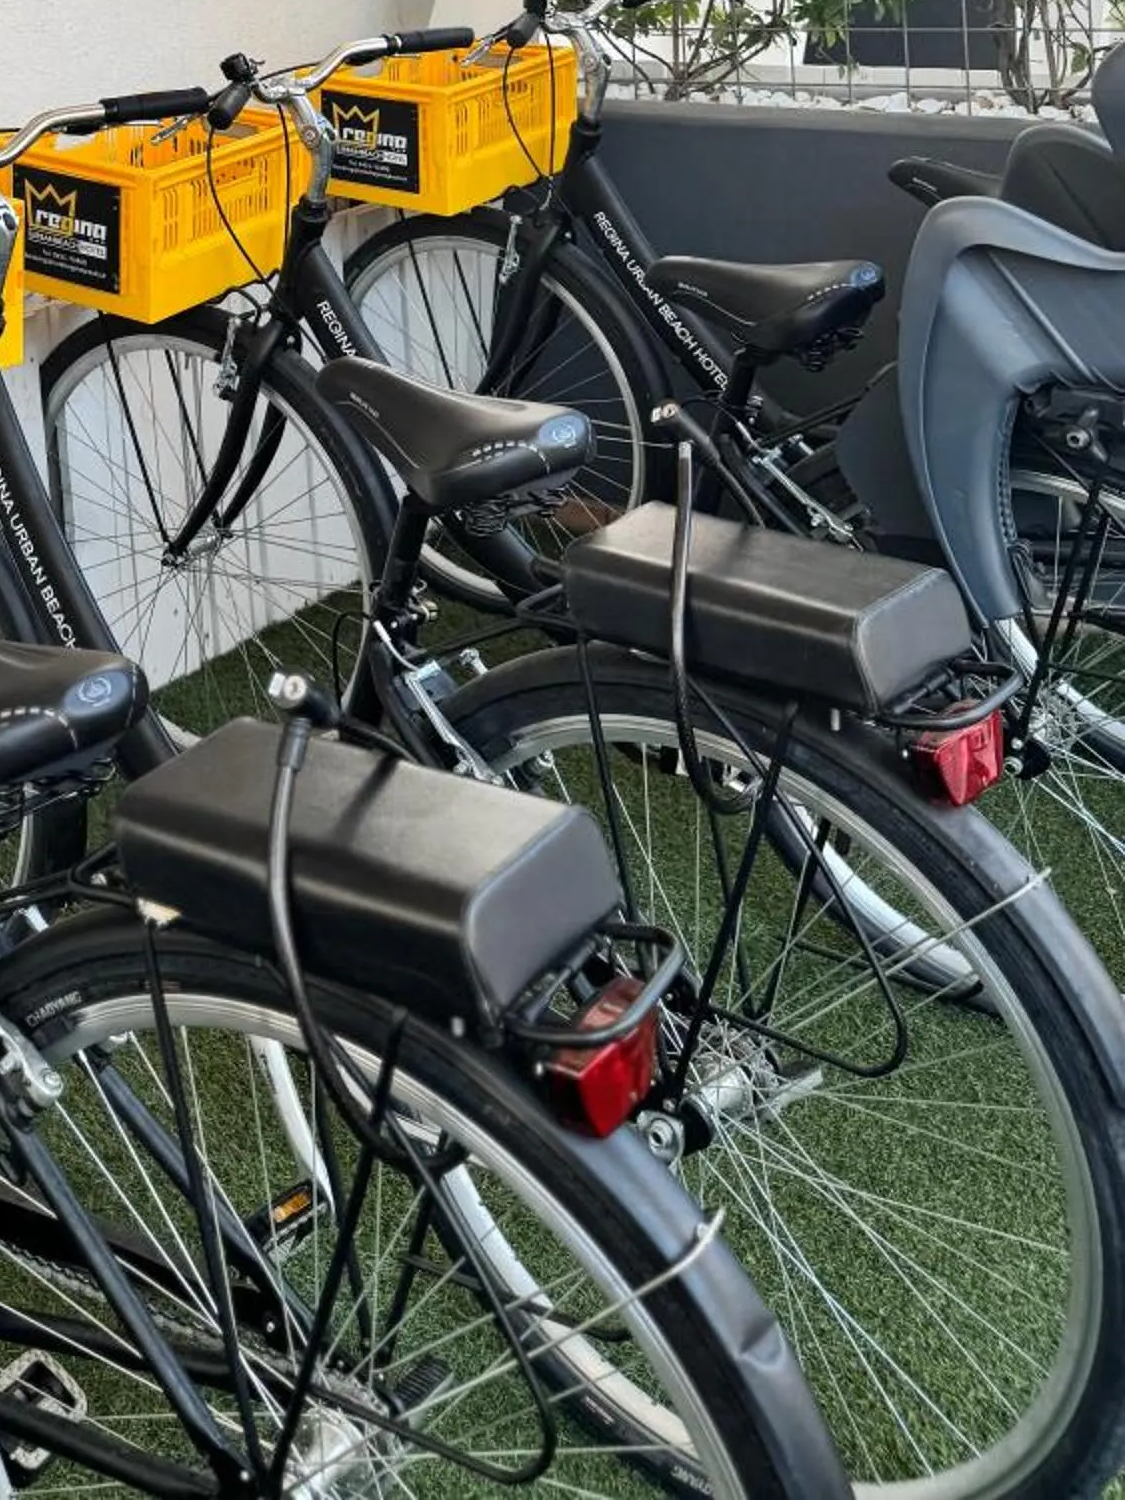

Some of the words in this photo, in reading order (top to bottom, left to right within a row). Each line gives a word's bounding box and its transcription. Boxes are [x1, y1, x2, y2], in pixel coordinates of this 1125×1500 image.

[342, 127, 408, 150] regina
[35, 209, 107, 241] regina
[593, 211, 630, 262] REGINA
[658, 303, 698, 350] BEACH
[693, 348, 729, 391] HOTEL
[10, 513, 47, 586] URBAN
